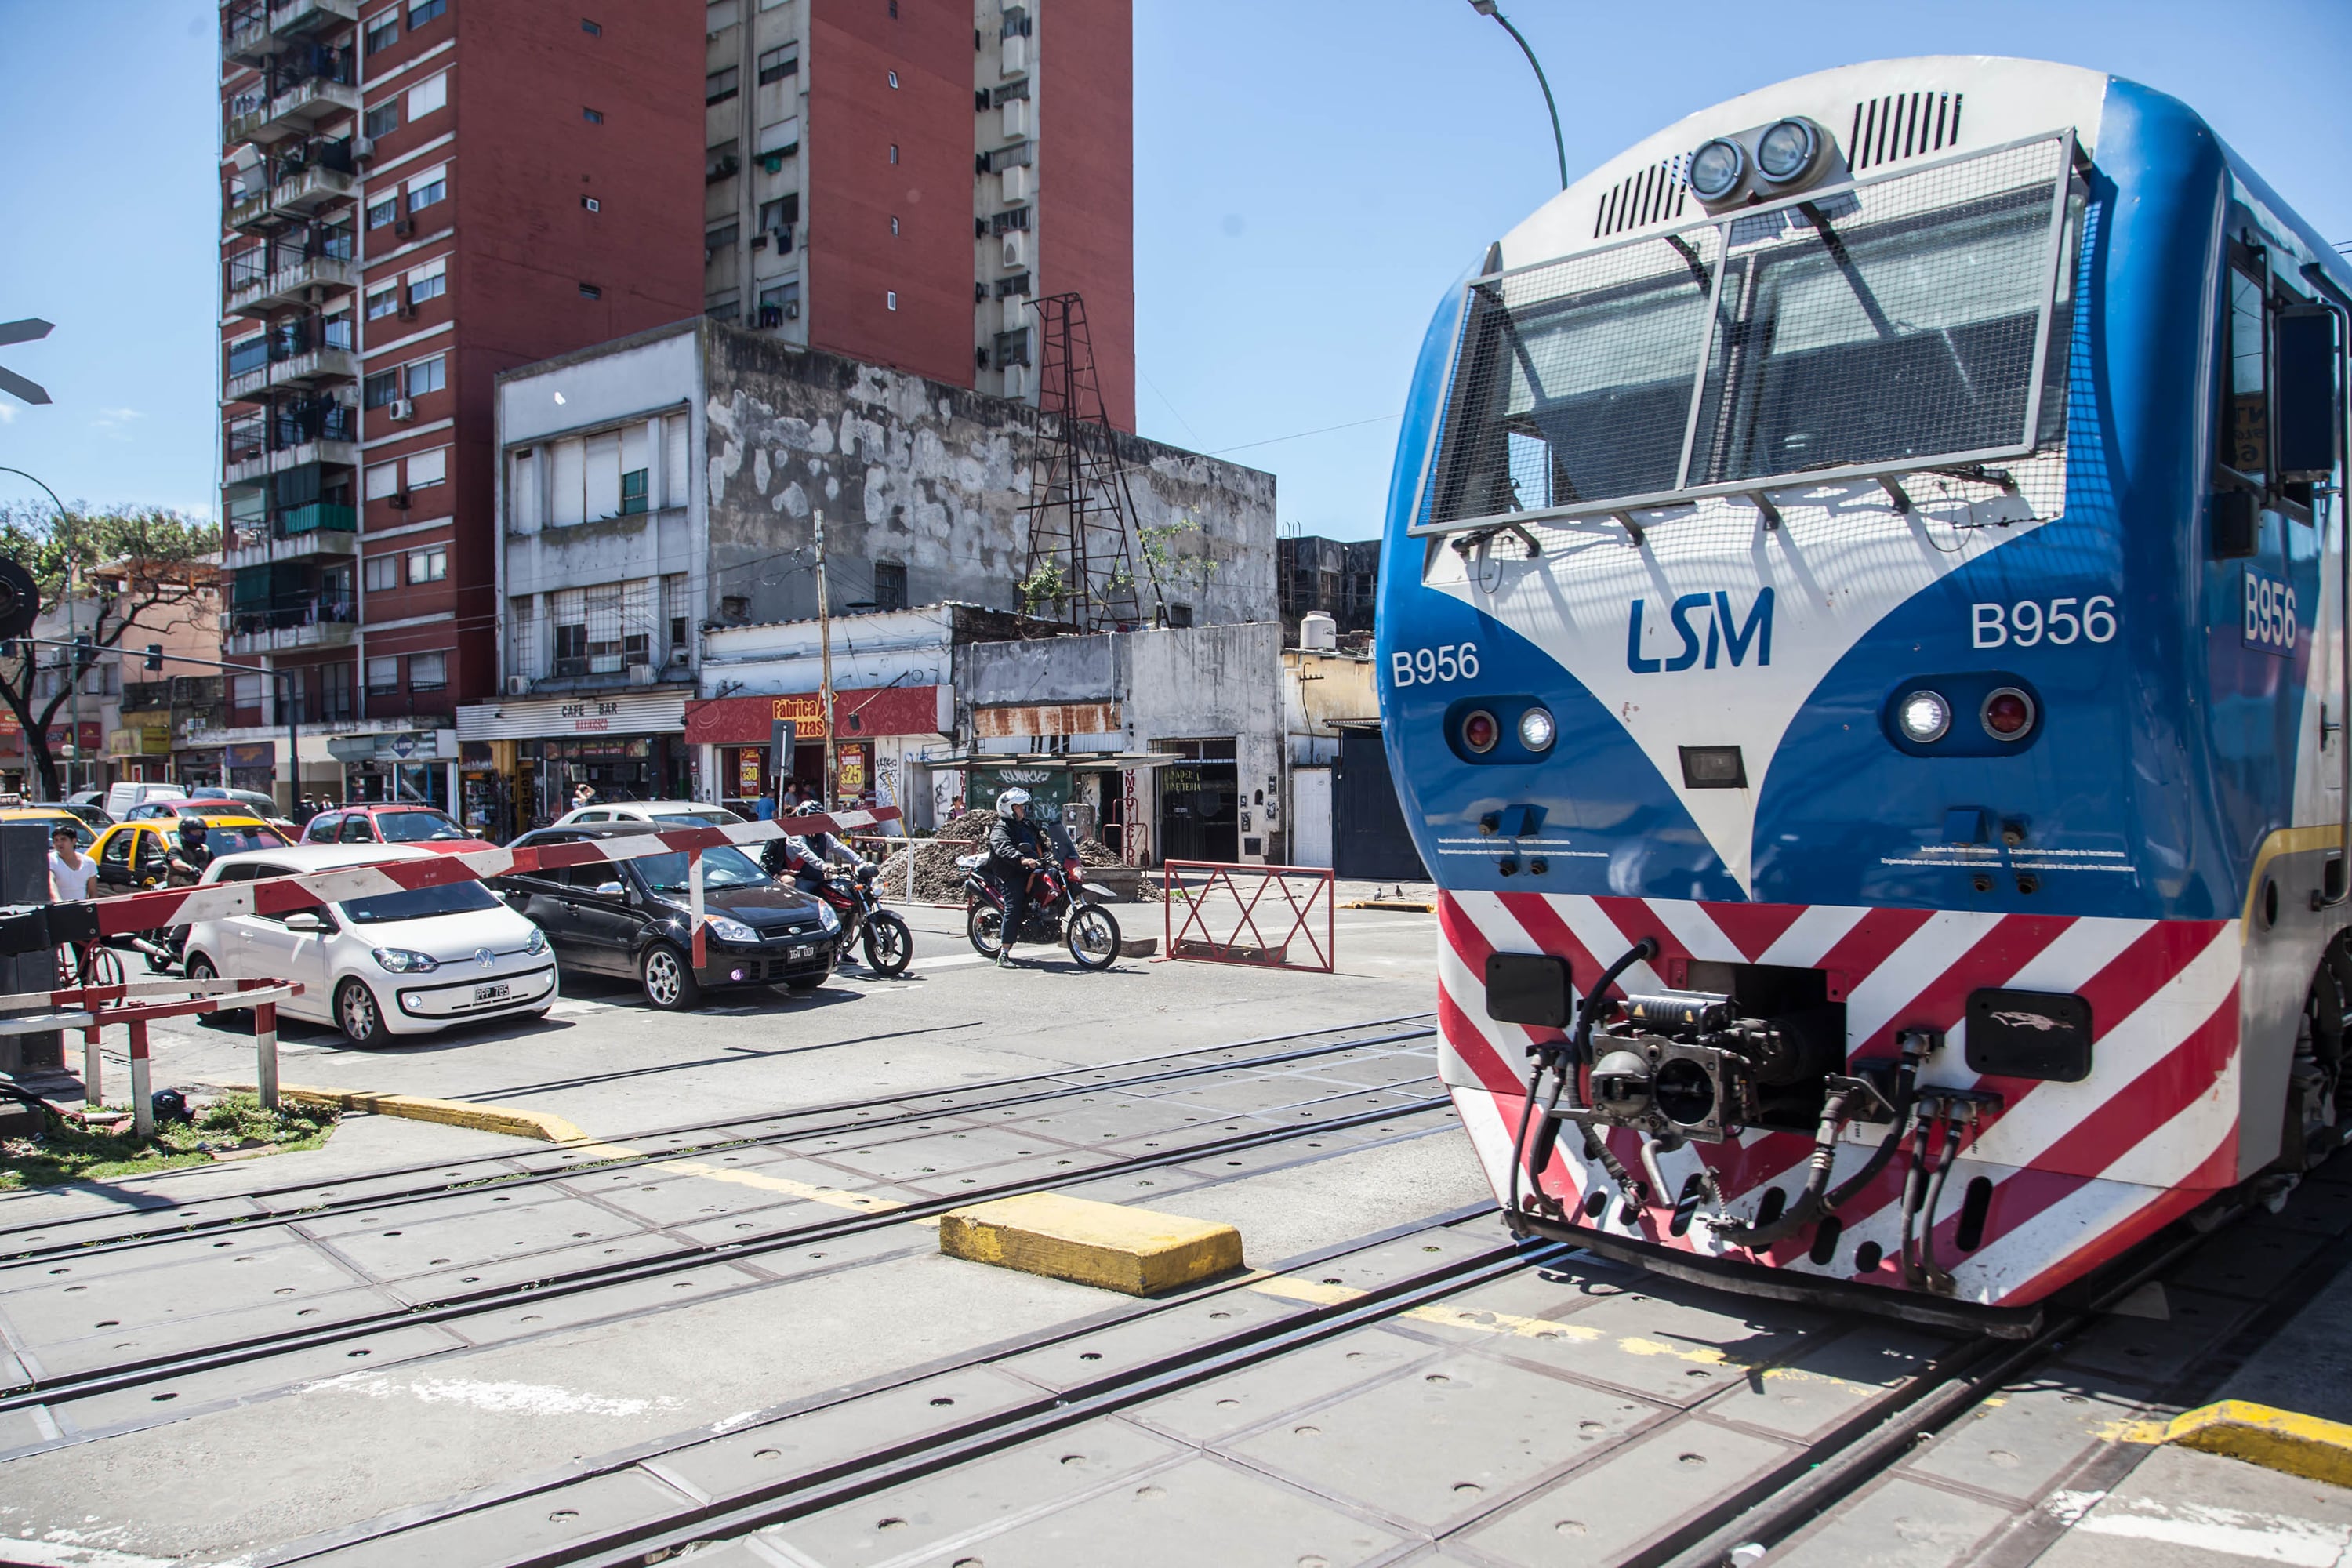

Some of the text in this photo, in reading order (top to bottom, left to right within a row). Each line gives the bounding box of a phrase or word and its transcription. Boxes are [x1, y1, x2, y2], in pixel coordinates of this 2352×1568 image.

[1972, 595, 2117, 648] B956
[2245, 572, 2296, 649] B956
[1628, 586, 1775, 673] LSM
[1392, 642, 1479, 688] B956
[561, 702, 618, 717] CAFE BAR
[773, 699, 817, 720] Fábrica
[840, 764, 862, 785] $25
[477, 985, 509, 1000] PPP 785
